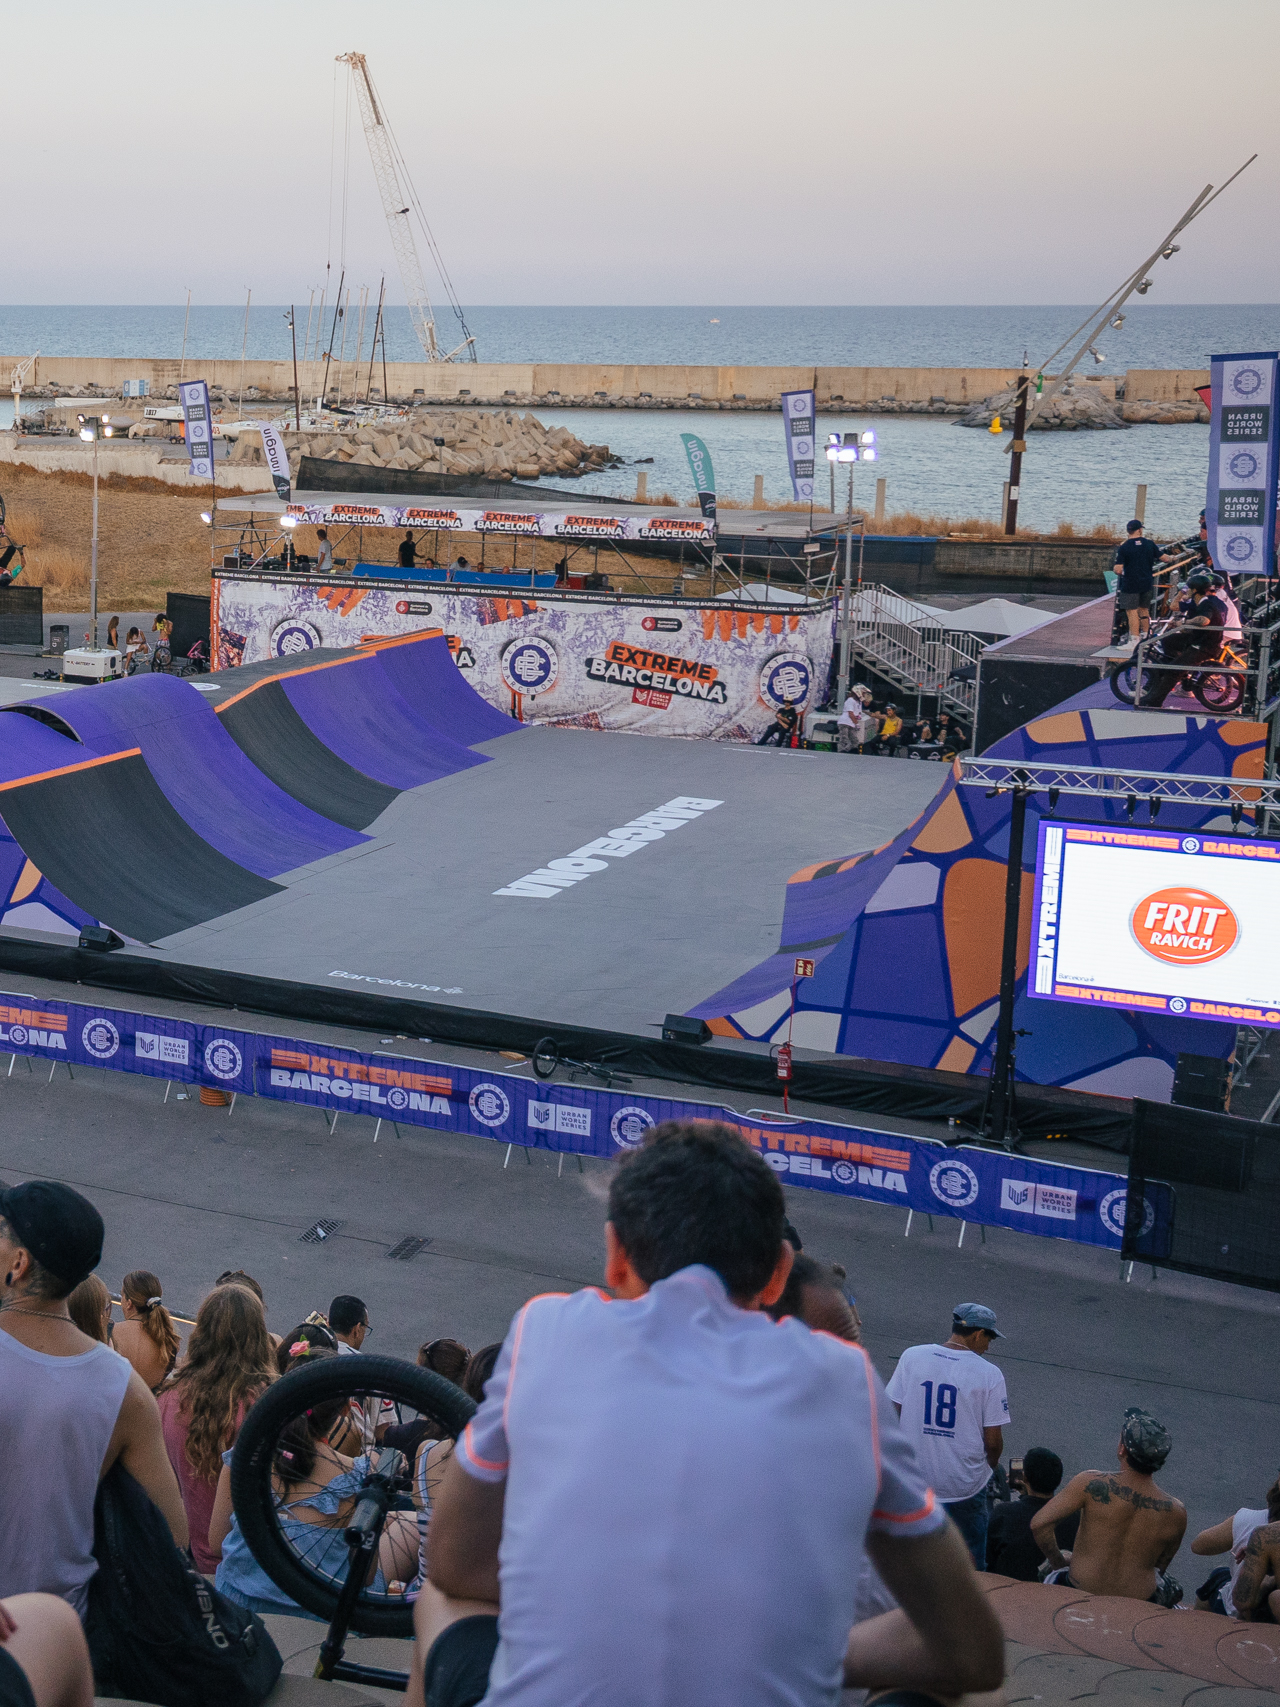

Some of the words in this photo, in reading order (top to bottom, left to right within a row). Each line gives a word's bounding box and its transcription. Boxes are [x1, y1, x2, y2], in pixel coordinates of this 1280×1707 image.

[263, 428, 281, 473] imagin
[687, 440, 708, 489] imagin
[334, 505, 378, 515] EXTREME
[409, 509, 455, 519] EXTREME
[325, 513, 384, 524] BARCELONA
[400, 517, 462, 528] BARCELONA
[485, 512, 533, 523] EXTREME
[566, 516, 616, 526] EXTREME
[476, 520, 540, 532] BARCELONA
[557, 524, 624, 536] BARCELONA
[651, 520, 702, 530] EXTREME
[641, 528, 710, 539] BARCELONA
[281, 621, 318, 647] EXTREME
[508, 637, 554, 657] EXTREME
[611, 645, 713, 680] EXTREME
[503, 666, 557, 694] BARCELONA
[590, 659, 724, 703] BARCELONA
[491, 796, 725, 898] BARCELONA
[1066, 828, 1179, 850] EXTREME
[1203, 841, 1280, 859] BARCEL
[1144, 901, 1227, 936] FRIT
[1150, 932, 1213, 951] RAVICH
[327, 970, 442, 993] Barcelona
[1055, 984, 1167, 1009] EXTREME
[164, 1041, 186, 1049] URBAN
[164, 1046, 186, 1054] WORLD
[164, 1052, 186, 1060] SERIES
[271, 1048, 452, 1095] EXTREME
[270, 1068, 452, 1116] BARCELONA
[561, 1111, 587, 1119] URBAN
[561, 1116, 587, 1125] WORLD
[561, 1122, 587, 1130] SERIES
[725, 1121, 911, 1171] XTREME
[1042, 1190, 1072, 1200] URBAN
[1041, 1197, 1072, 1207] WORLD
[1041, 1203, 1072, 1214] SERIES
[920, 1380, 958, 1429] 18
